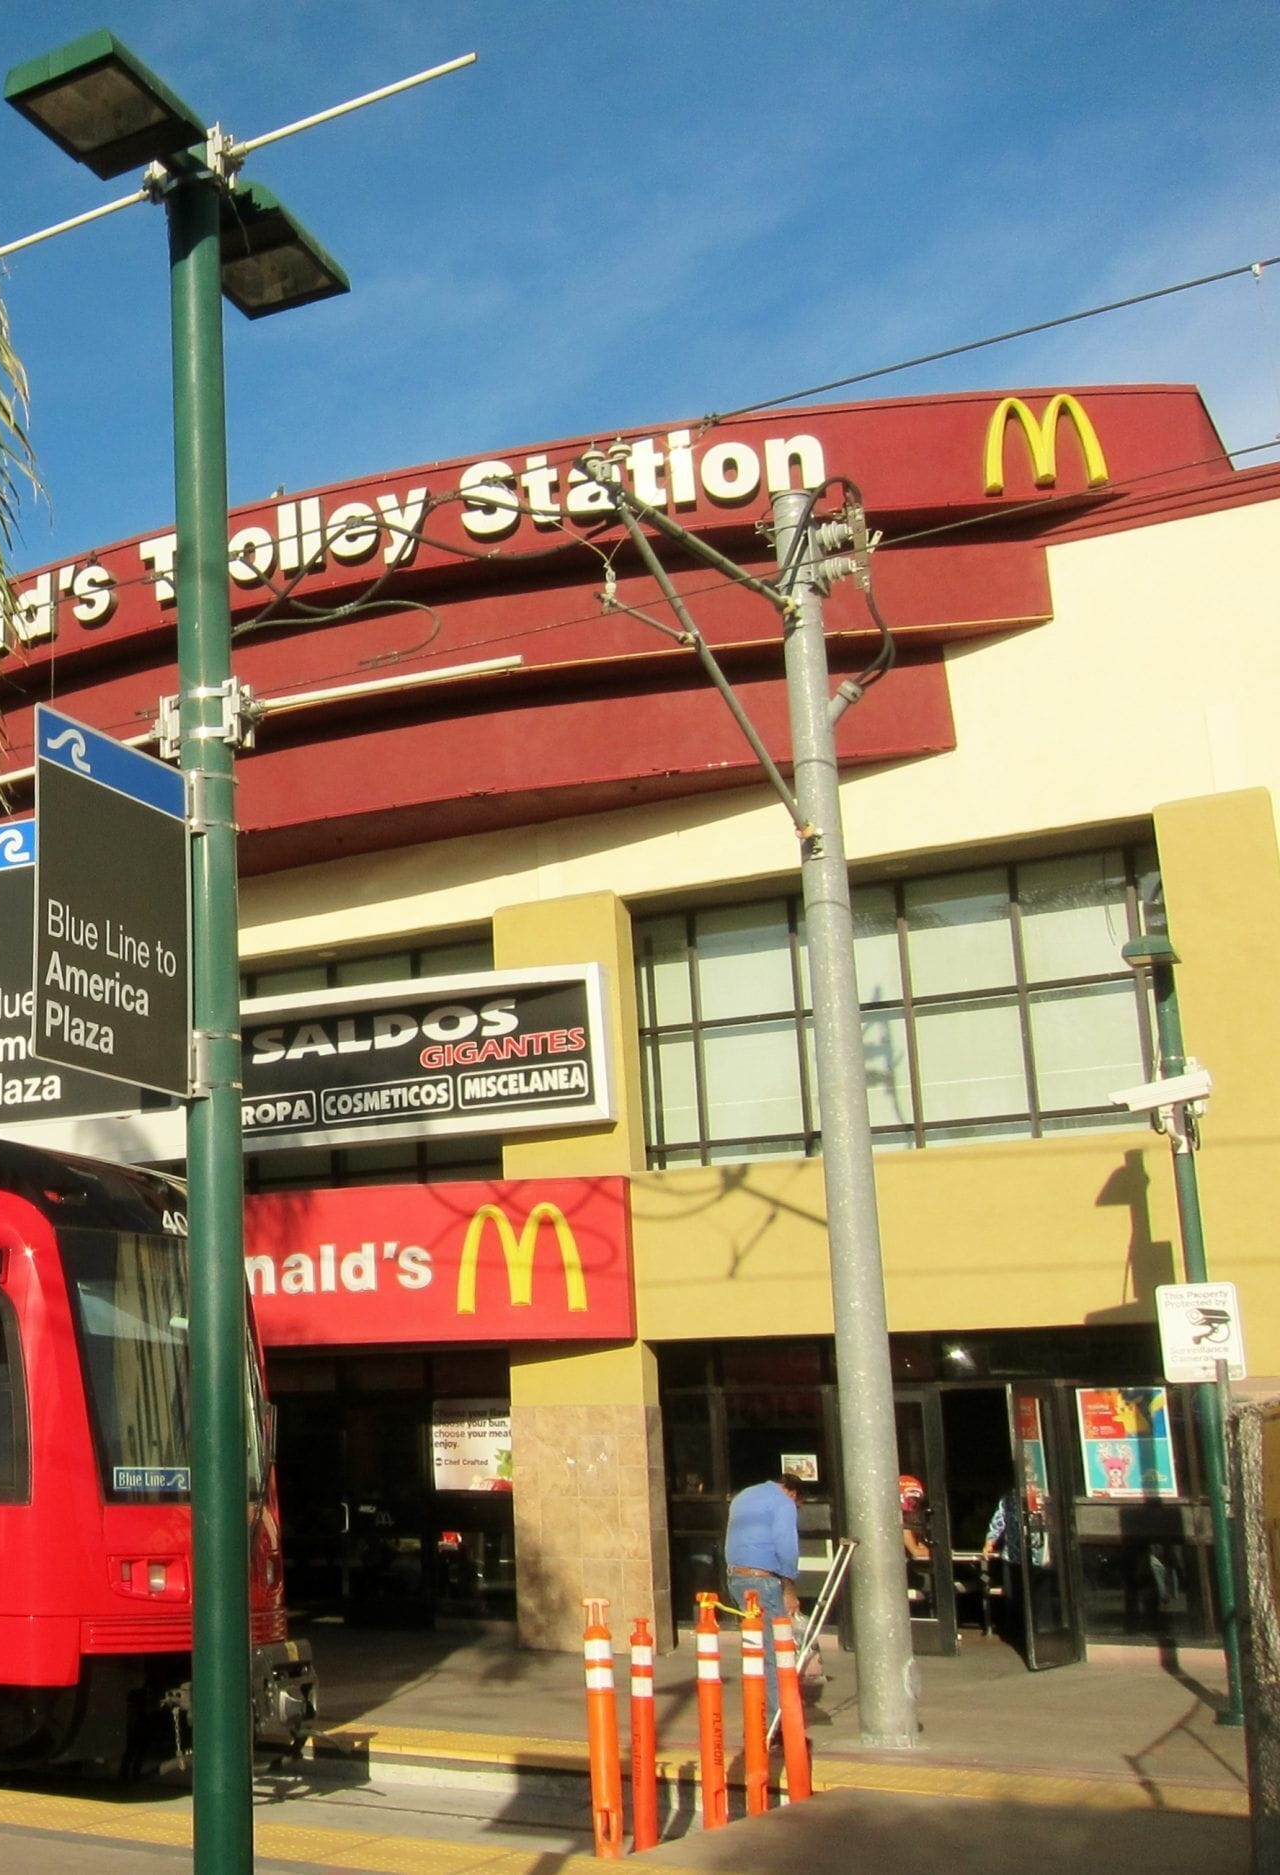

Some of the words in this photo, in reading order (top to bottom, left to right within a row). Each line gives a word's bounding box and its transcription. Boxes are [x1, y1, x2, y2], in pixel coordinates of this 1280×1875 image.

[139, 487, 428, 602] Tolley
[460, 430, 827, 536] Station
[47, 899, 98, 951] Blue
[106, 920, 150, 968] Line
[156, 940, 177, 977] to
[45, 951, 150, 1017] America
[45, 1000, 114, 1055] Plaza
[252, 999, 519, 1064] SALDOS
[420, 1027, 586, 1069] GIGANTES
[325, 1082, 450, 1117] COSMETICOS
[464, 1066, 585, 1100] MISCELANEA
[241, 1099, 311, 1125] ROPA
[467, 1430, 487, 1439] your
[119, 1472, 142, 1487] Blue
[145, 1472, 166, 1487] Line
[444, 1458, 460, 1466] Chef
[462, 1458, 489, 1466] Crafted
